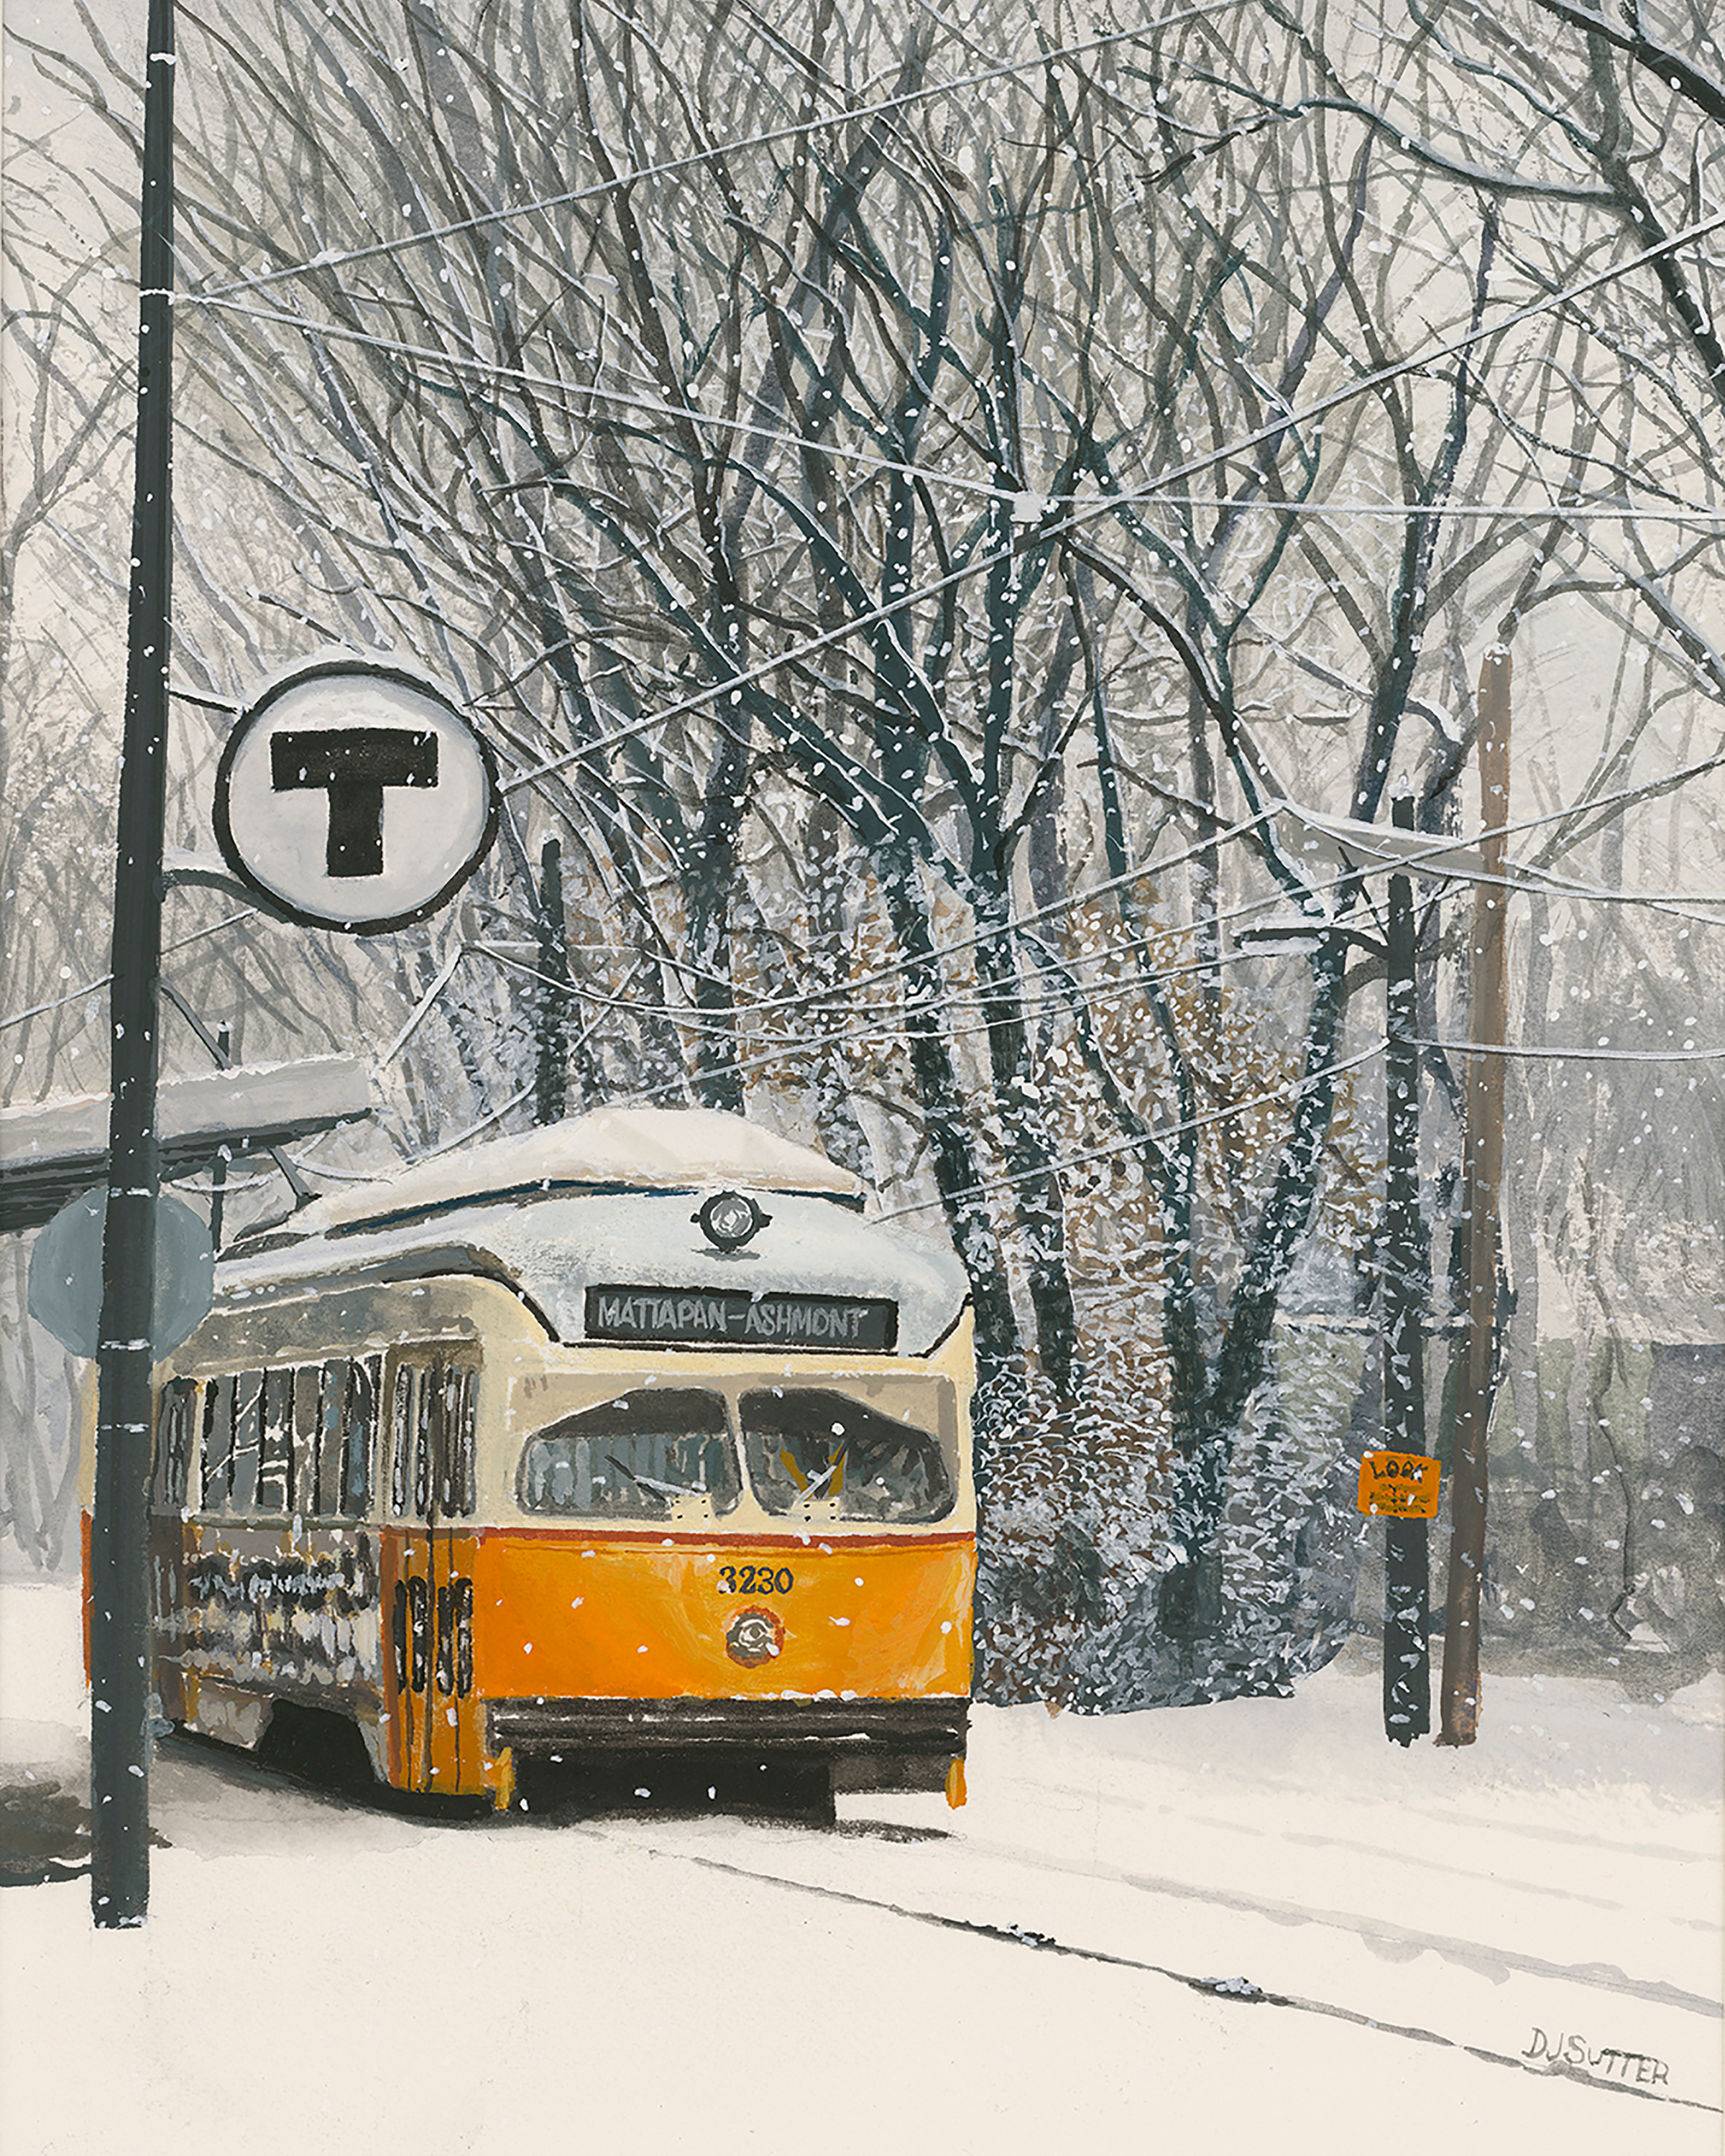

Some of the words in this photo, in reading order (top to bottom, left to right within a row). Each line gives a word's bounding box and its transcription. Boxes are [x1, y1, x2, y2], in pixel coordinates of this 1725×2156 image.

[270, 727, 439, 877] T
[597, 1296, 865, 1338] MATTAPAN-ASHMONT
[719, 1565, 794, 1595] 3230
